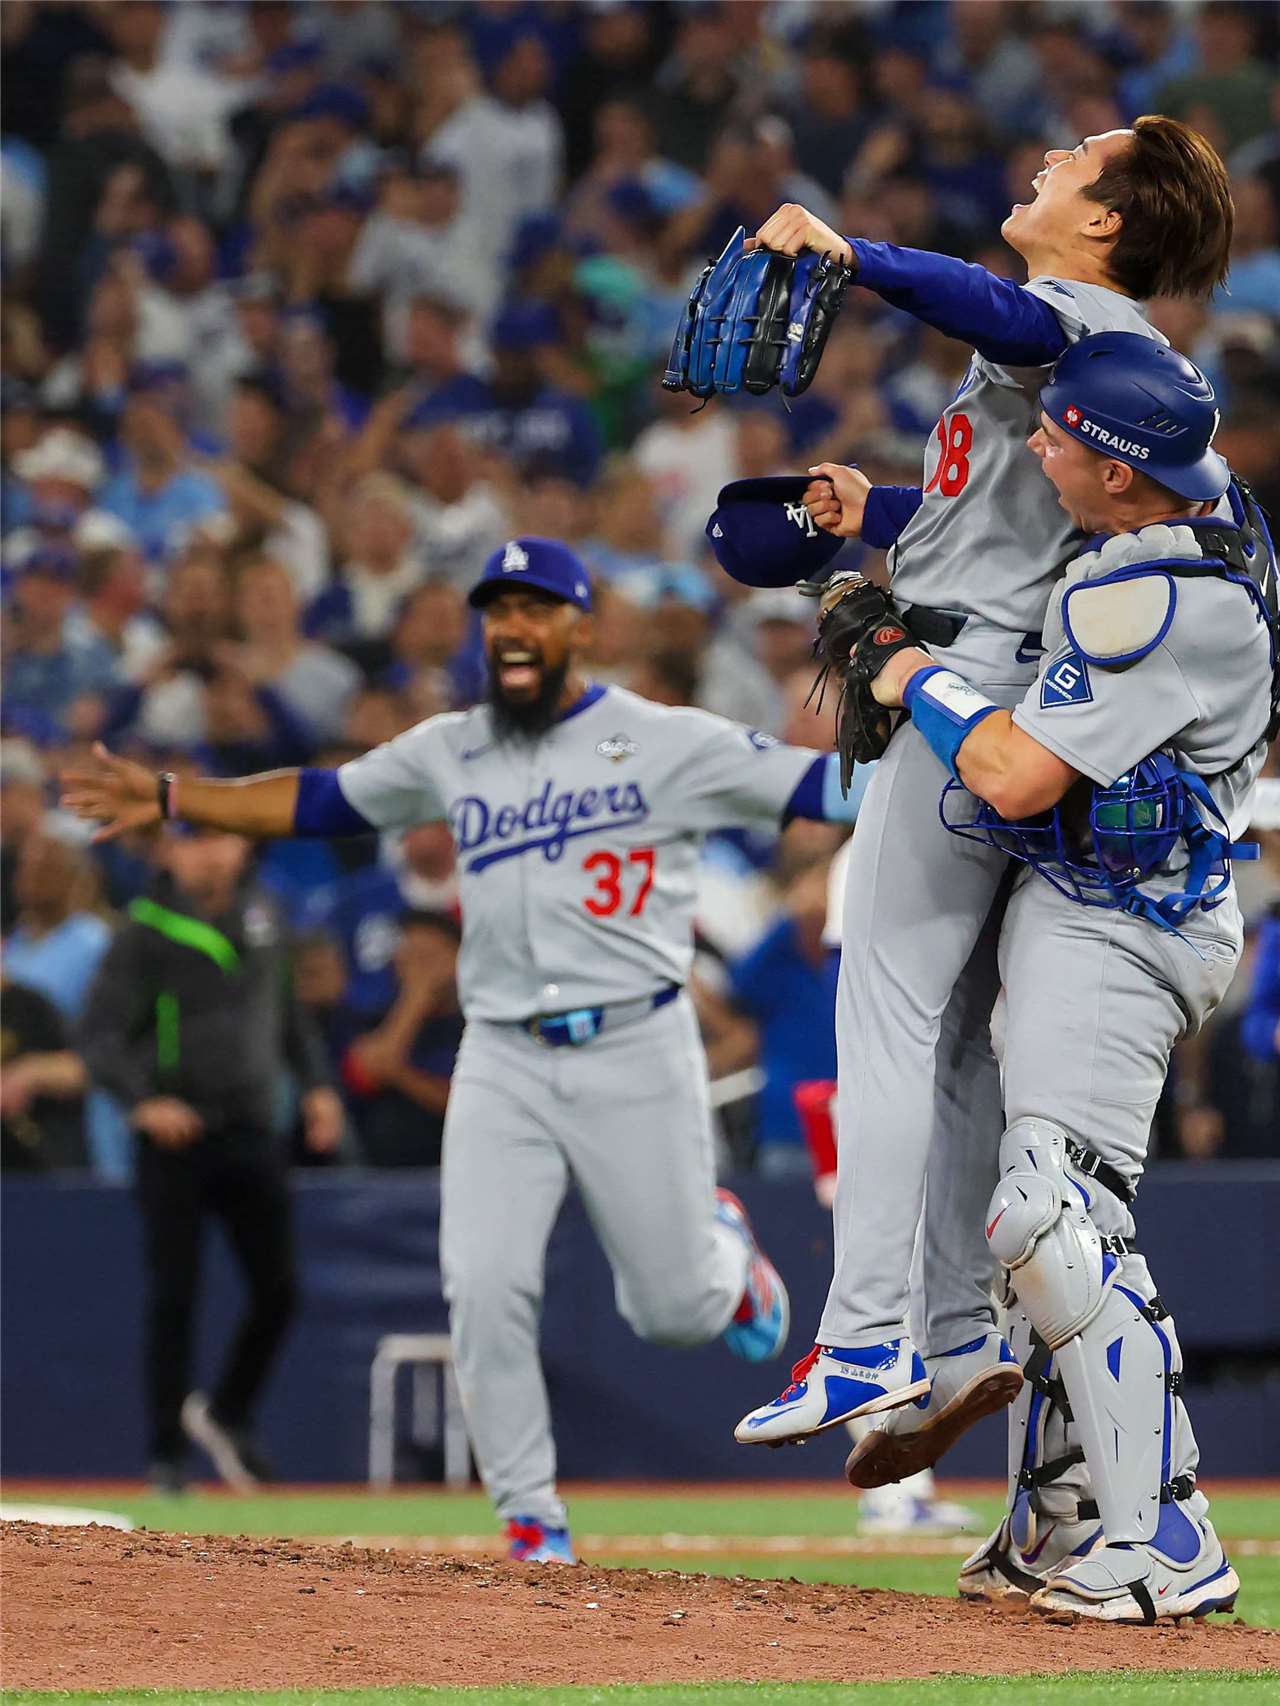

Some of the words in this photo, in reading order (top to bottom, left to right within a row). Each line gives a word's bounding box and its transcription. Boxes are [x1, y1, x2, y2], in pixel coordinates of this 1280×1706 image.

[1080, 419, 1150, 460] STRAUSS
[1054, 662, 1081, 690] G
[460, 780, 649, 873] Dodgers
[582, 848, 656, 918] 37
